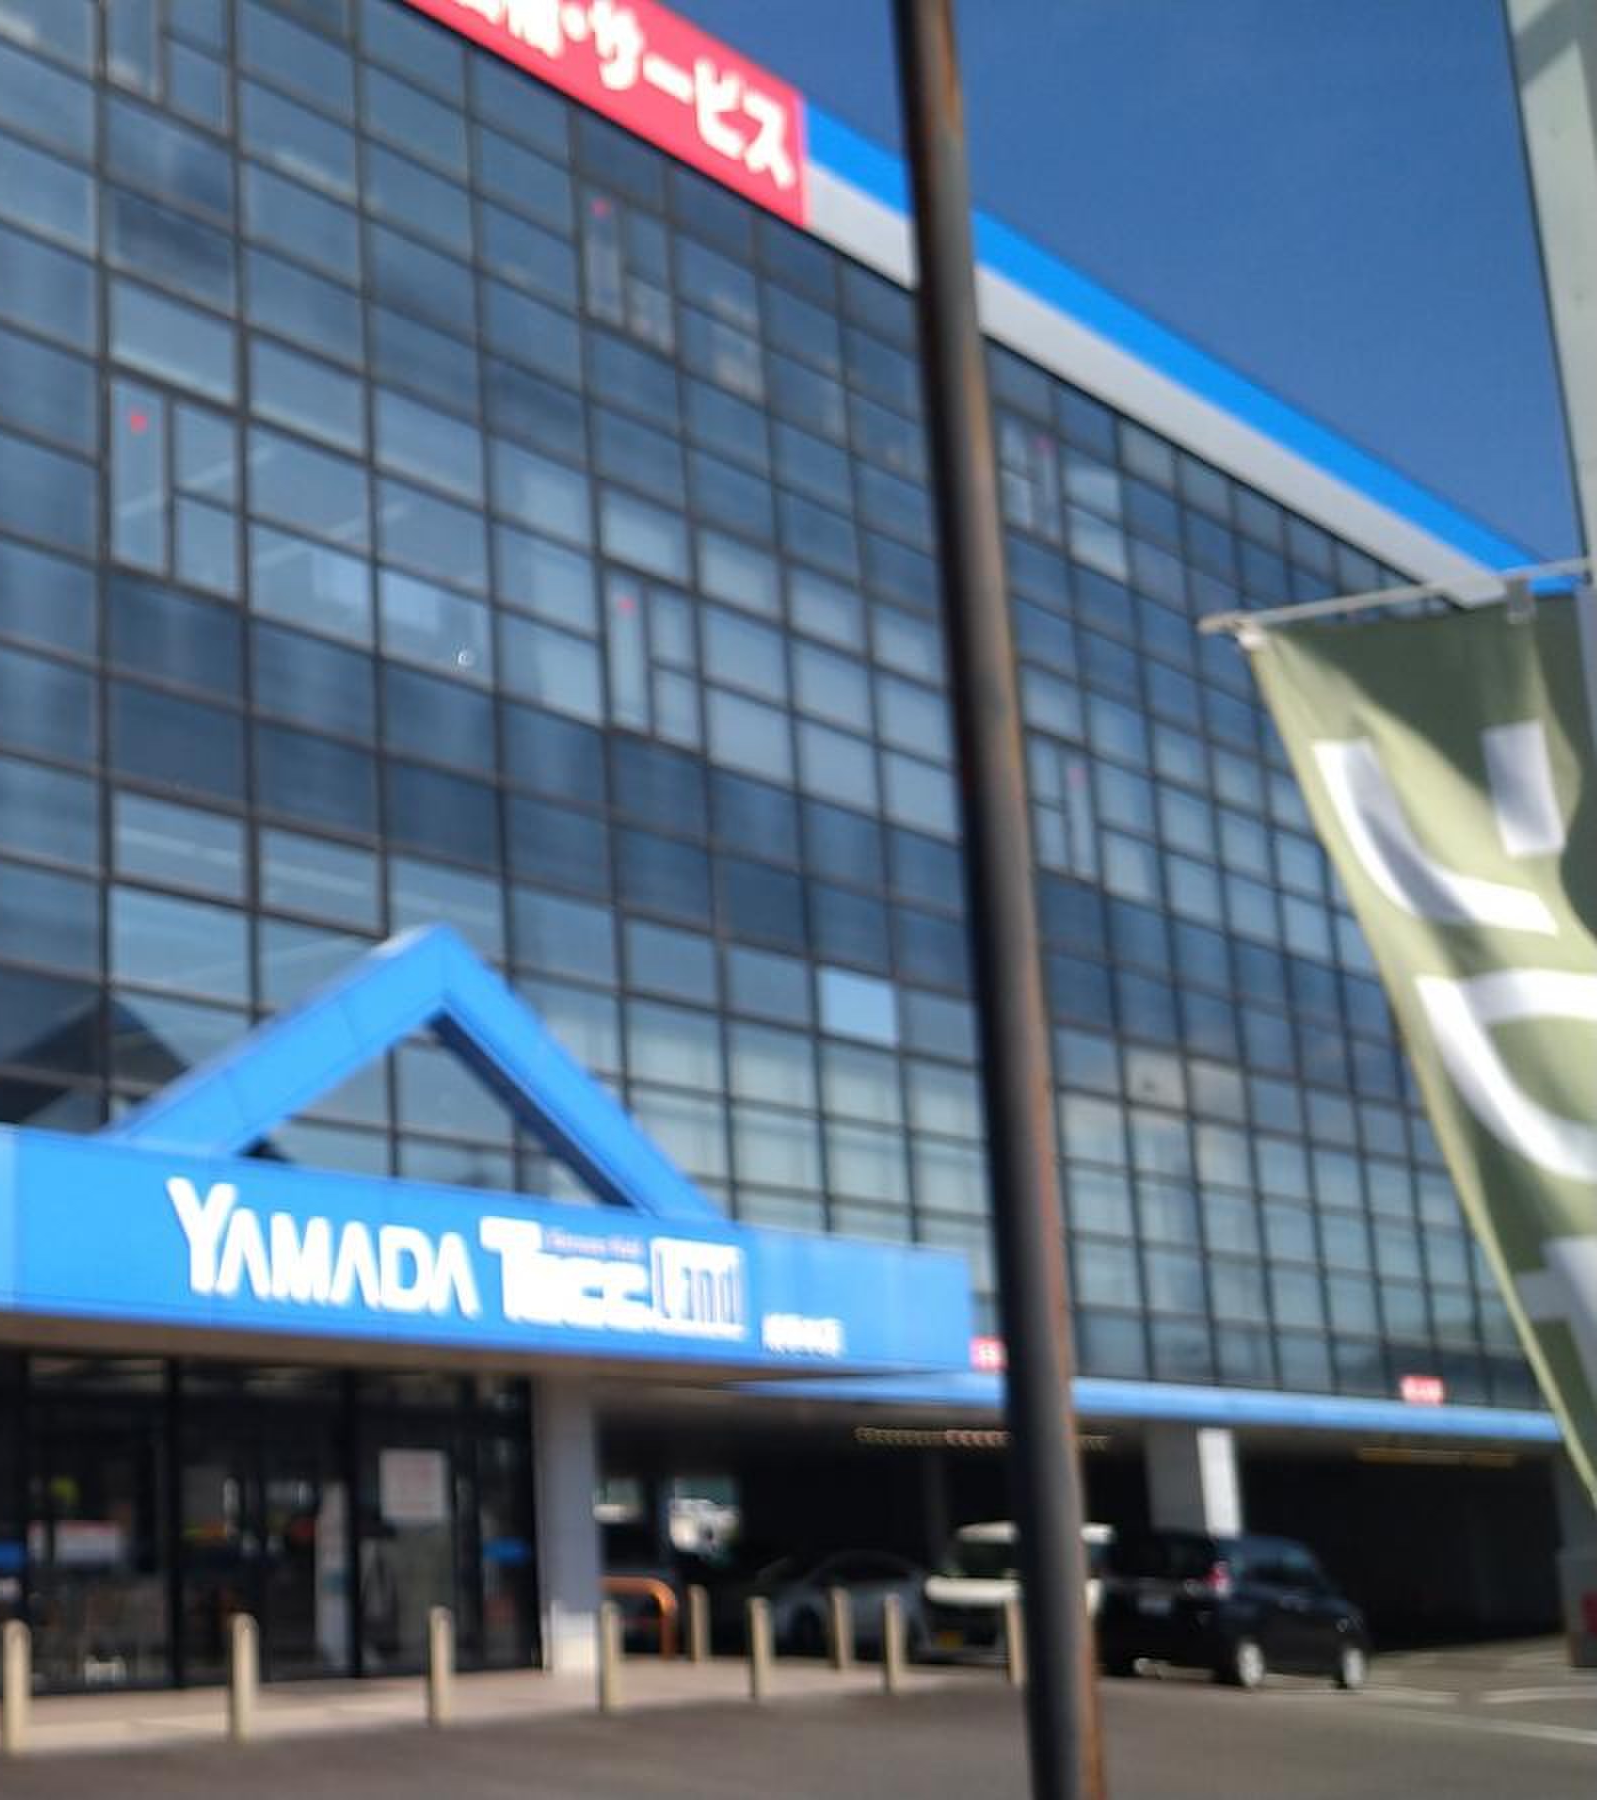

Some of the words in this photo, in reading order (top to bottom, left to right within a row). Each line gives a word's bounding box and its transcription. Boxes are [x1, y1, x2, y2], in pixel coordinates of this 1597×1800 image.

[458, 0, 798, 189] ・サービス
[166, 1176, 481, 1318] YAMADA
